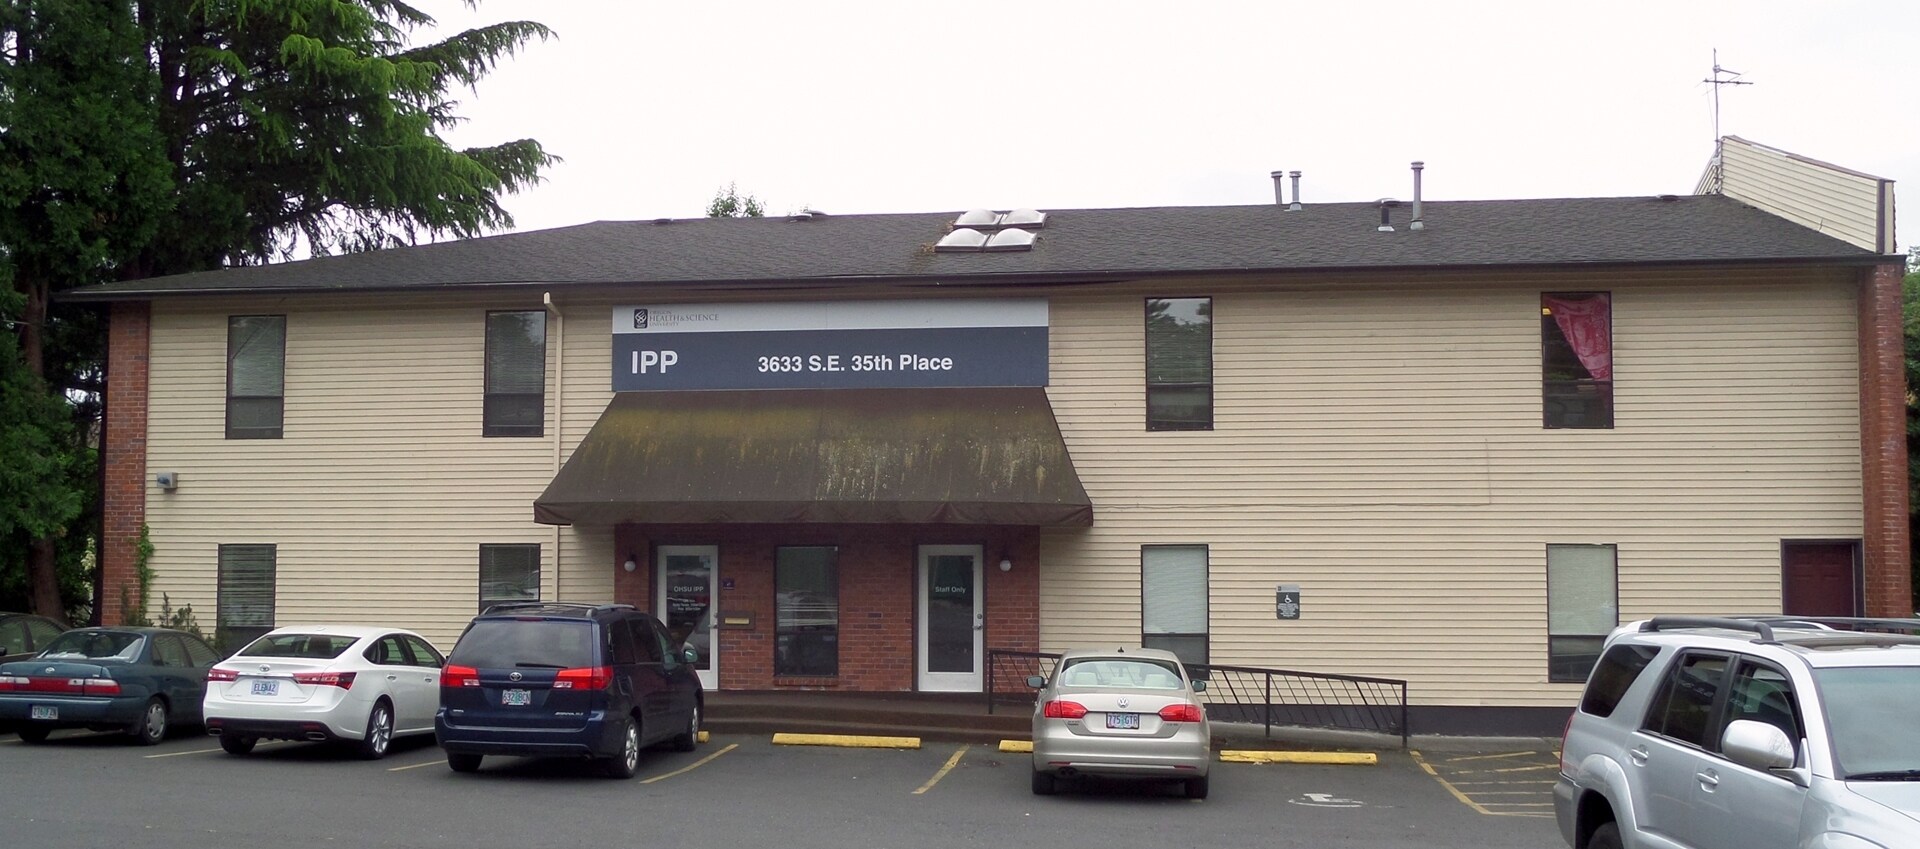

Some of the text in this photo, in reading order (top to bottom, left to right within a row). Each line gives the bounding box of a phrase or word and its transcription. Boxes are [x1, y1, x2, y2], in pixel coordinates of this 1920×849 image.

[631, 351, 678, 374] IPP
[758, 354, 953, 372] 3633 S.E. 35th Place
[951, 586, 966, 594] Only
[1108, 715, 1120, 724] 775
